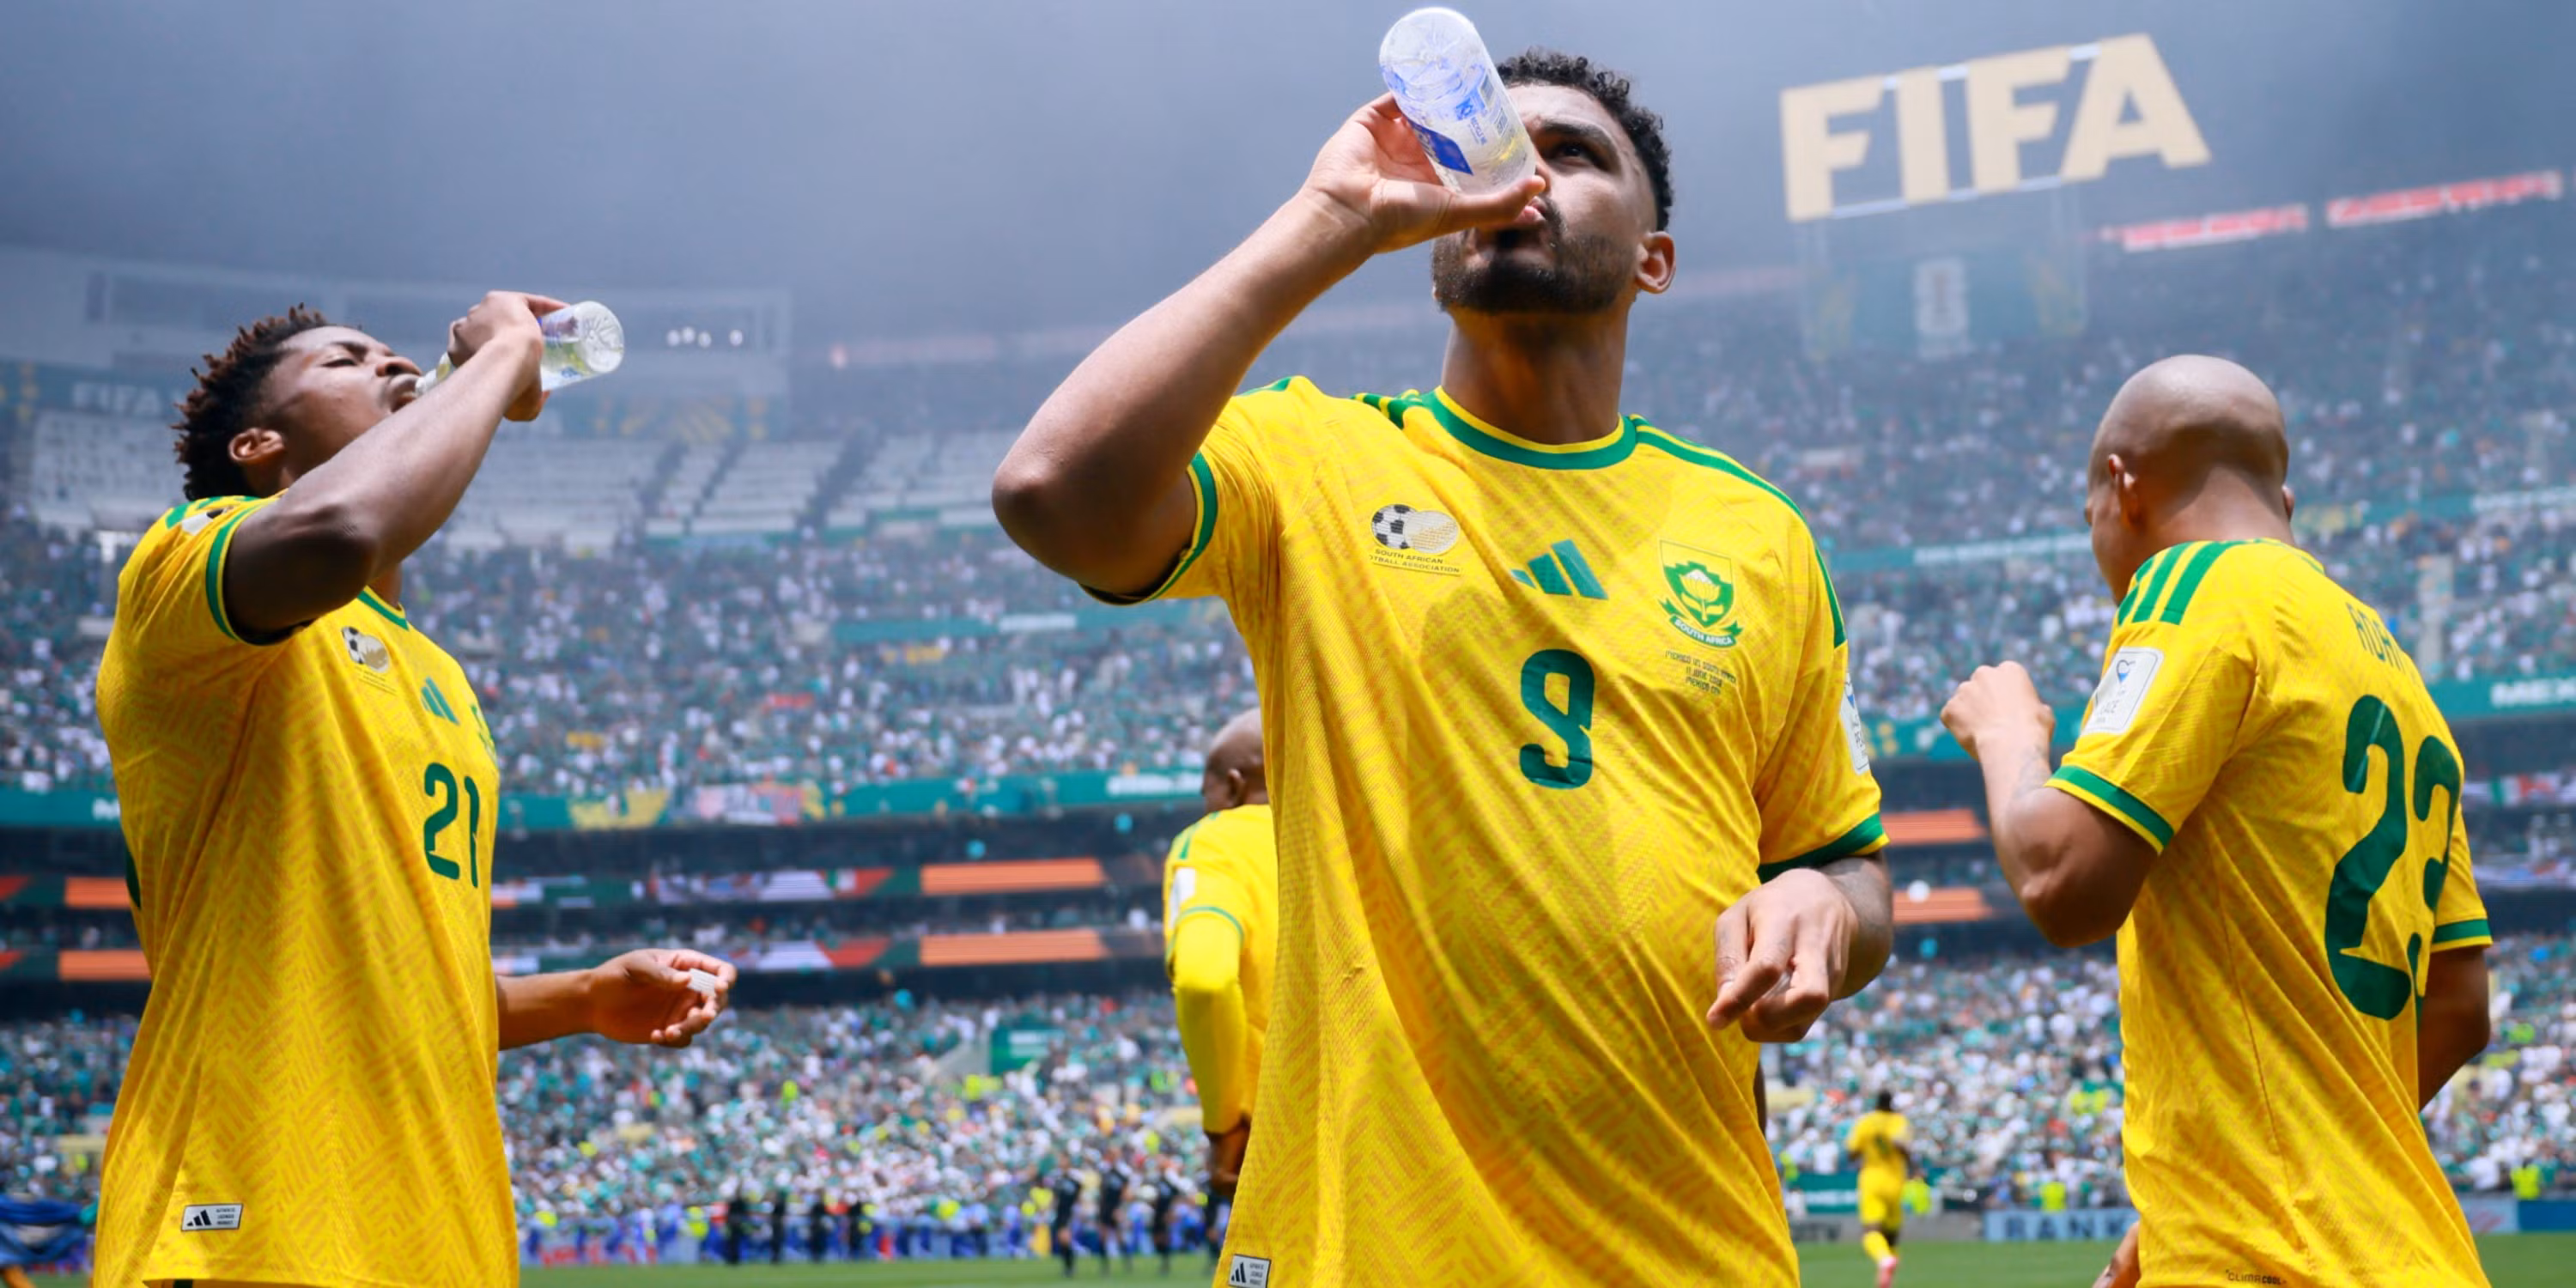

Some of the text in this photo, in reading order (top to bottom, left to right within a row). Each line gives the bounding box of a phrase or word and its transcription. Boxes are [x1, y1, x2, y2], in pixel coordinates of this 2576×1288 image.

[1780, 33, 2212, 221] FIFA
[73, 383, 163, 415] FIFA
[1375, 549, 1443, 564] SOUTH AFRICAN
[1402, 561, 1460, 573] ASSOCIATION
[1674, 617, 1733, 646] SOUTH AFRICA
[1519, 648, 1595, 790] 9
[423, 762, 479, 889] 21
[2324, 694, 2462, 1035] 23
